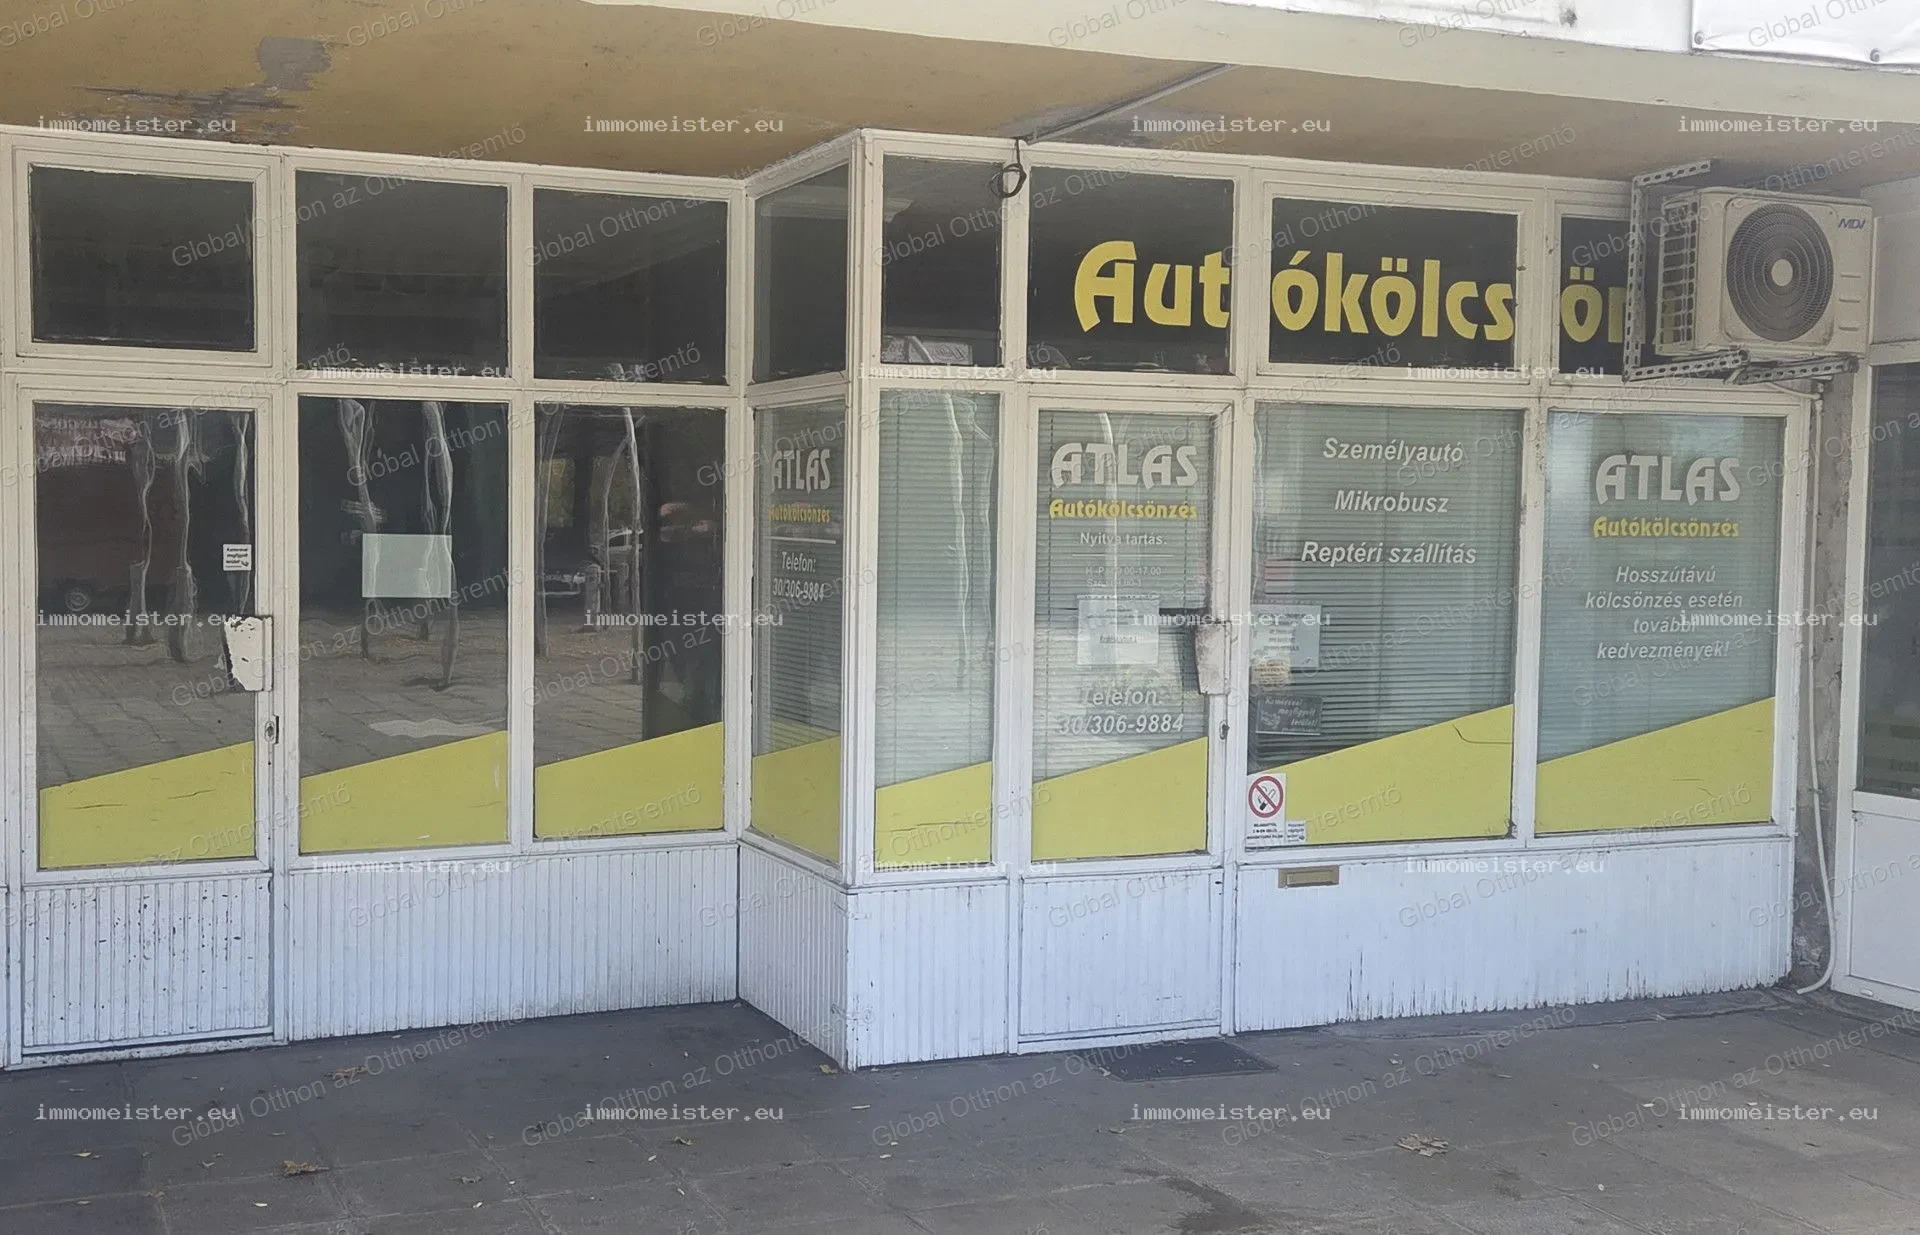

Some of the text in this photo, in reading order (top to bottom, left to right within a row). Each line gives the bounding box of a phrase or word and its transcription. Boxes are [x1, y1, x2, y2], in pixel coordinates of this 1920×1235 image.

[1323, 437, 1463, 466] Személyautó
[771, 448, 831, 494] ATLAS
[1051, 442, 1198, 490] ATLAS
[1595, 454, 1741, 506] ATLAS
[1049, 499, 1198, 520] Autókölcsönzés
[1334, 490, 1449, 513] Mikrobusz
[1592, 516, 1740, 538] Autókölcsönzés
[1080, 531, 1122, 547] Nyitva
[782, 551, 816, 573] Telefon:
[1301, 541, 1477, 567] Reptéri szállítás
[1615, 565, 1716, 583] Hosszútávú
[772, 578, 825, 601] 30/306-9884
[1585, 591, 1743, 610] kölcsönzés esetén
[1597, 640, 1730, 662] kedvezmények!
[1059, 713, 1184, 735] 30/306-9884
